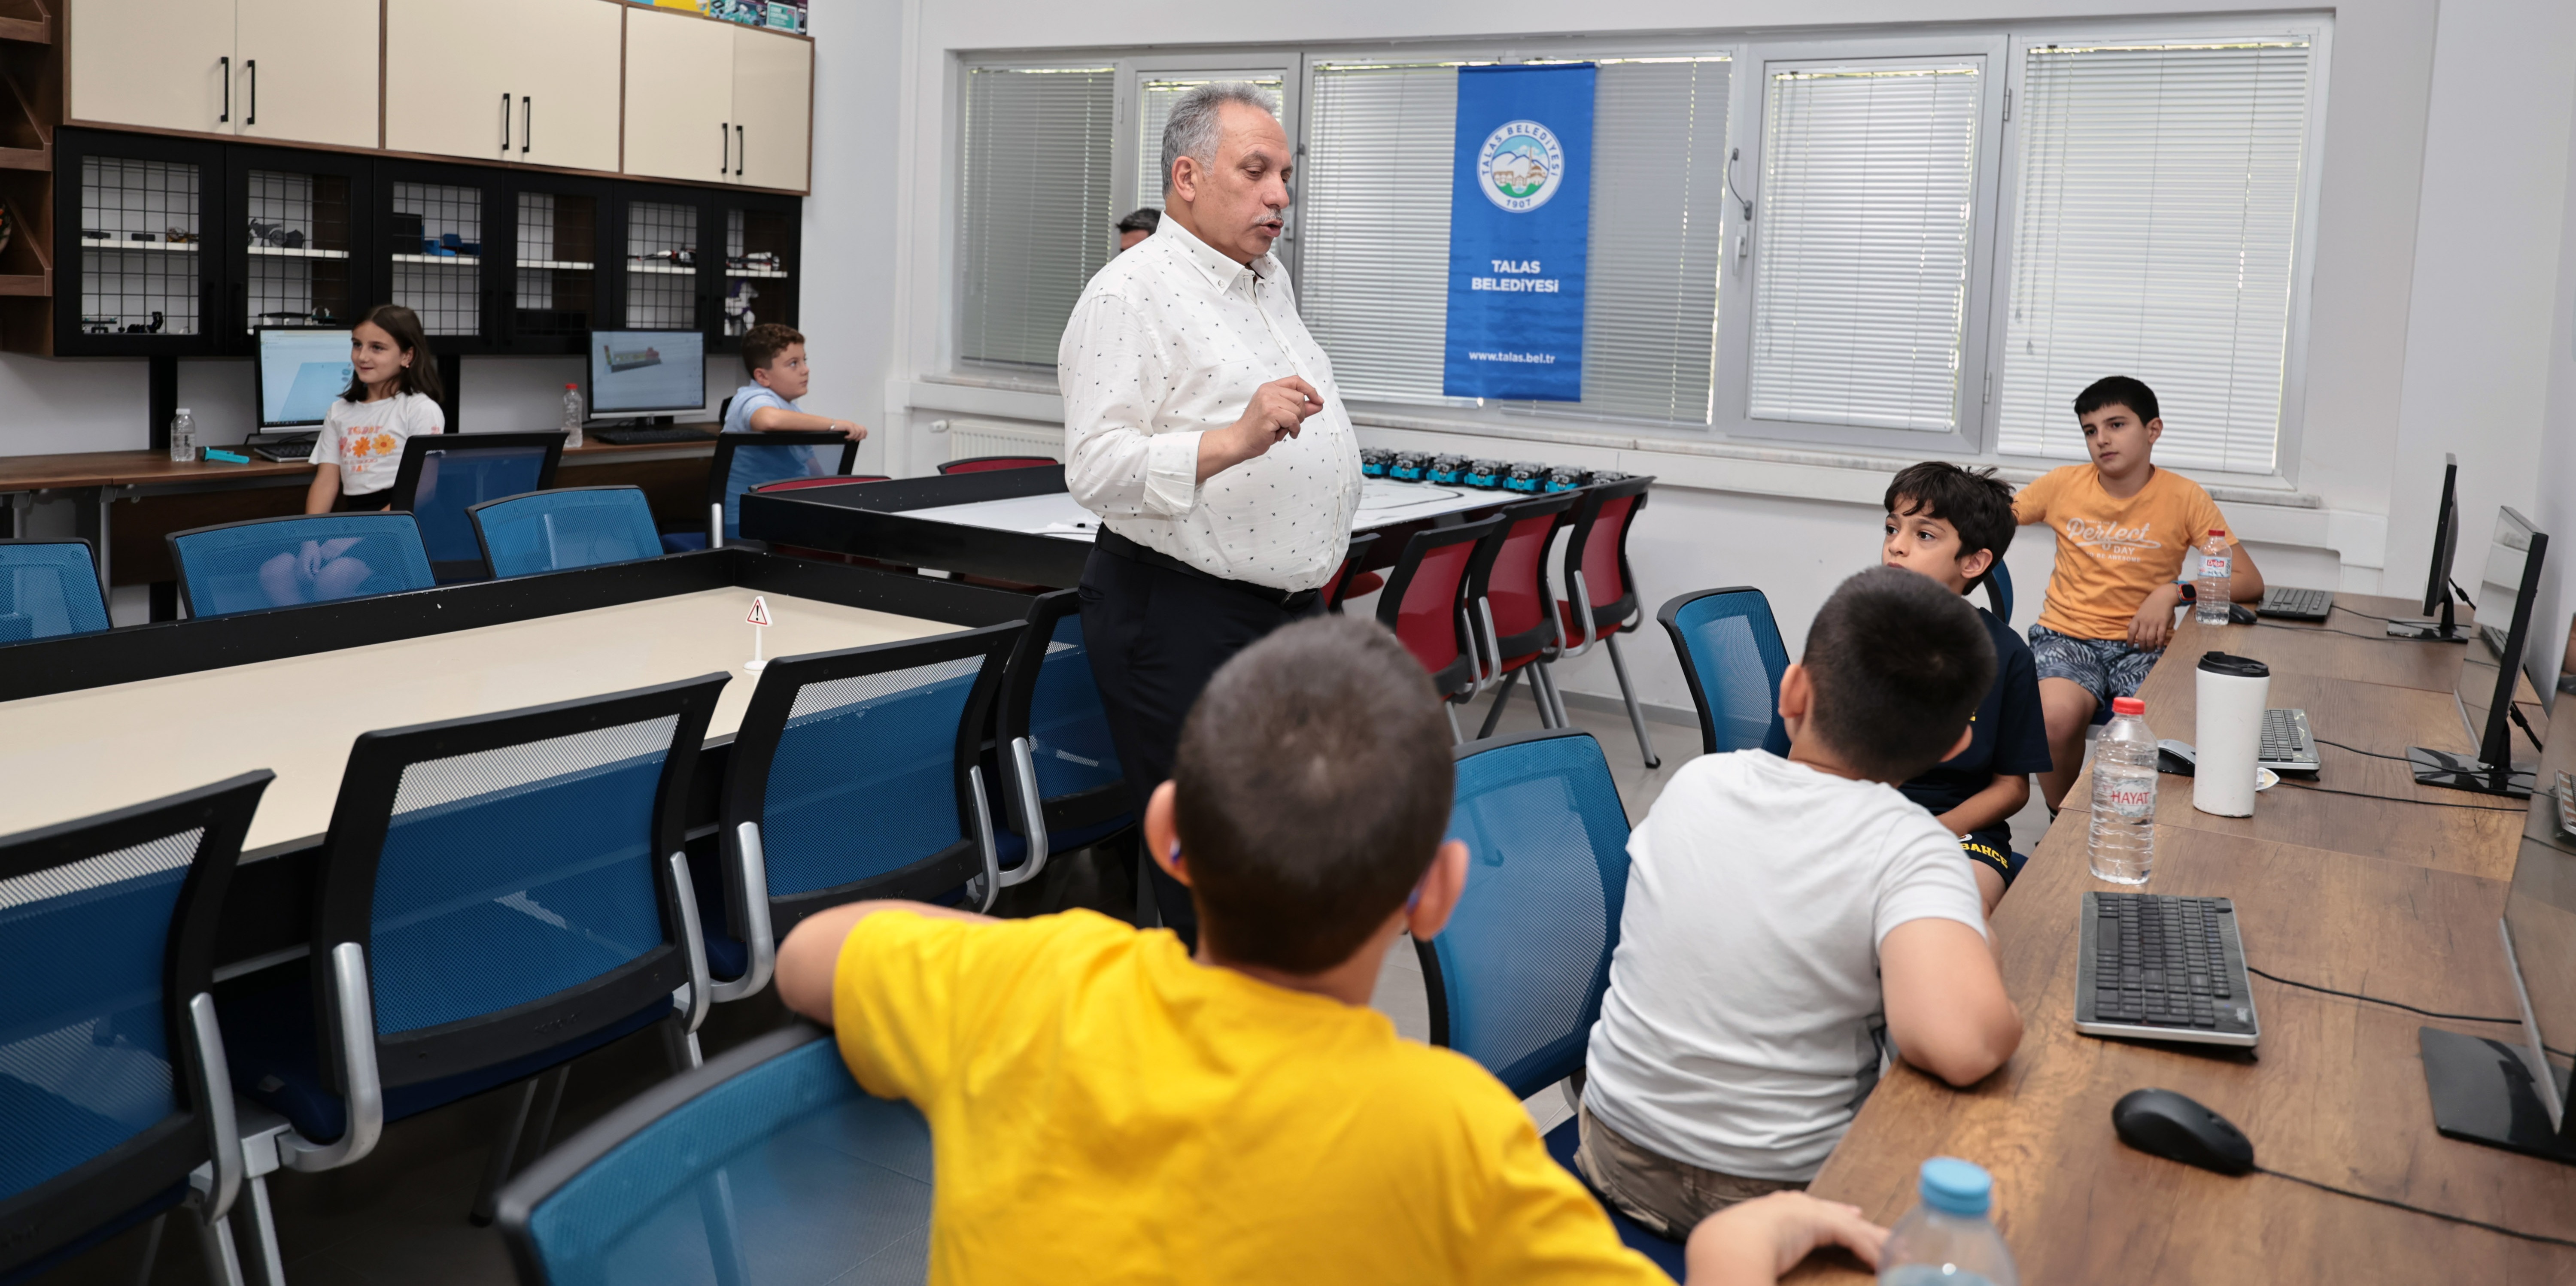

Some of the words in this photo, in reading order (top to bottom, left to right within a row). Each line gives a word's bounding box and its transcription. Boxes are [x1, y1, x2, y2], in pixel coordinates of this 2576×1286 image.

[1482, 134, 1502, 176] TALAS
[1507, 199, 1531, 208] 1907
[1491, 260, 1541, 274] TALAS
[1471, 277, 1559, 293] BELEDİYESİ
[1468, 352, 1556, 364] www.talas.bel.tr
[2066, 517, 2161, 551] Perfect
[2113, 545, 2135, 555] DAY
[2108, 554, 2142, 563] AWESOME
[2111, 790, 2150, 804] HAYAT
